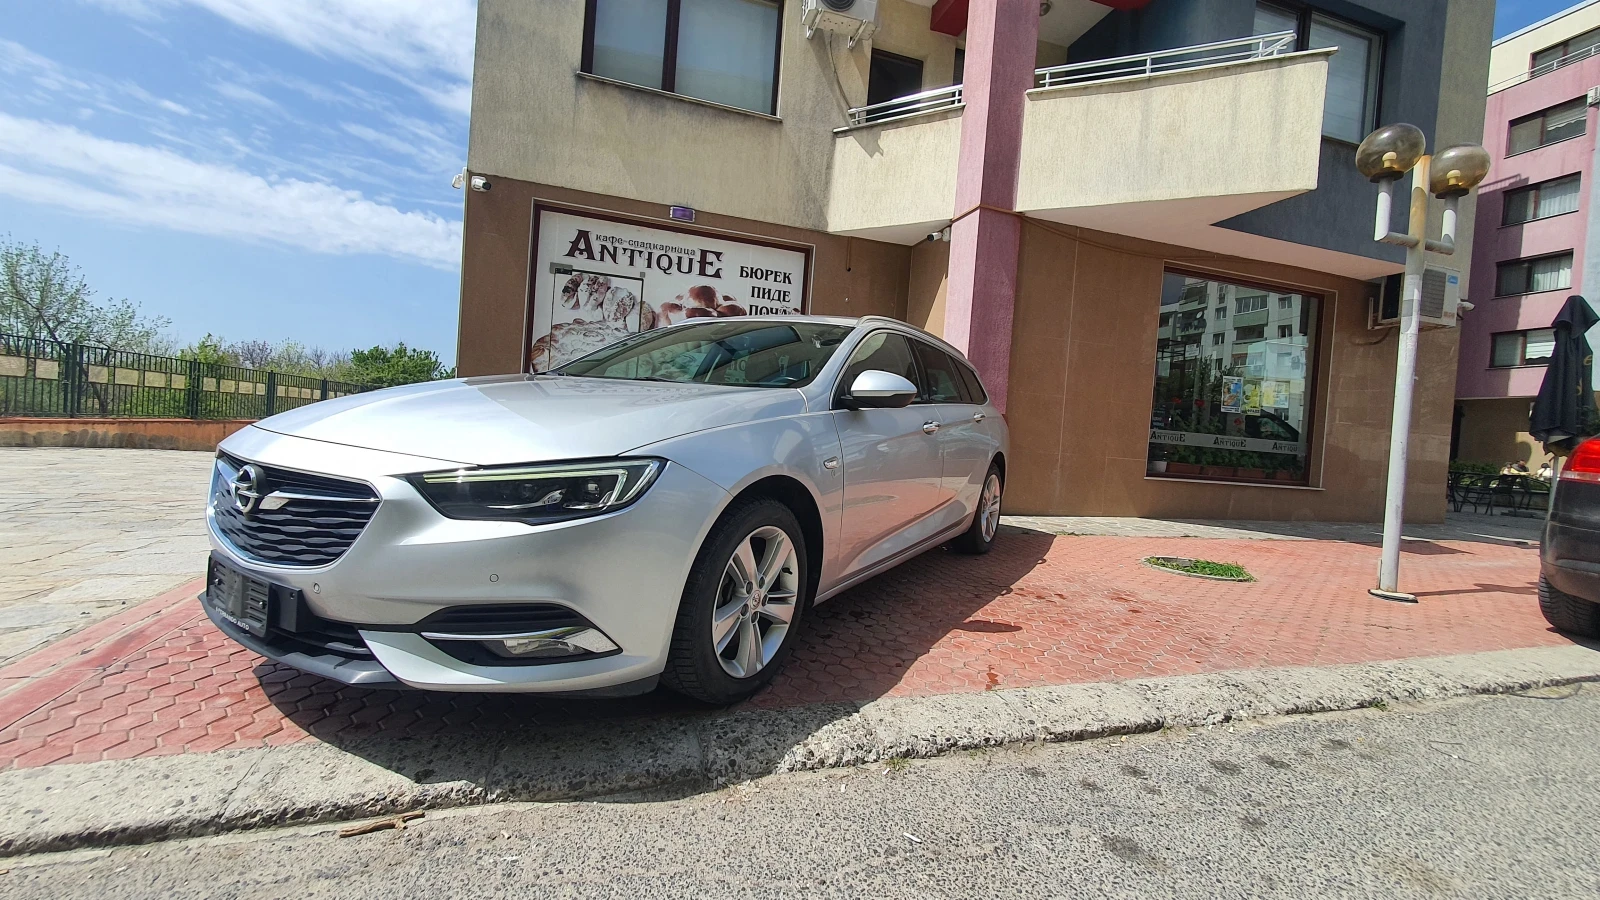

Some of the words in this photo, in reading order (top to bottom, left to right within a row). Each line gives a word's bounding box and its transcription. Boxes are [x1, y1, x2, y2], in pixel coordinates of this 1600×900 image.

[563, 228, 723, 279] ANTIQUE
[595, 233, 696, 256] кафе-сладкарница
[739, 265, 792, 285] БЮРЕК
[750, 286, 791, 304] ПИДЕ
[1150, 430, 1186, 443] ANTIQUE
[1213, 436, 1247, 448] ANTIQUE
[1272, 442, 1303, 452] ANTIQU
